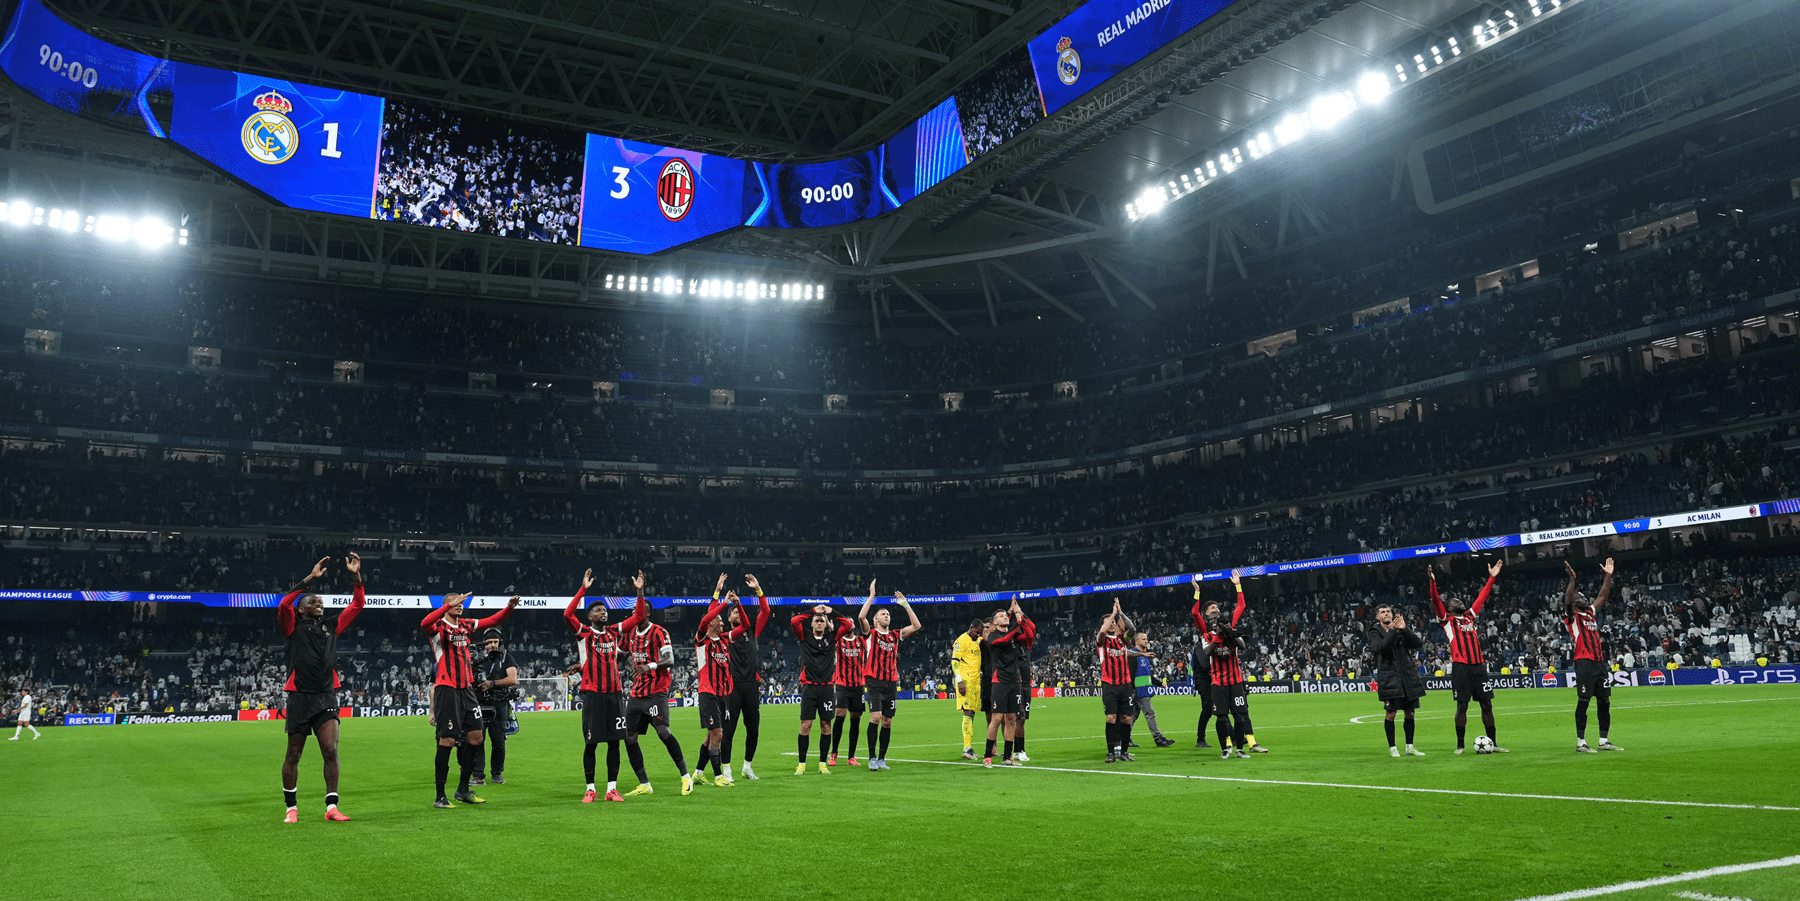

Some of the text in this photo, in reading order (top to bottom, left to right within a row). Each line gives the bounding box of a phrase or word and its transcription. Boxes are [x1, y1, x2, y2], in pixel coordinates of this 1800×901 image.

[1097, 20, 1126, 47] REAL
[40, 44, 98, 88] 90:00
[321, 123, 342, 158] 1
[666, 163, 687, 176] ACM
[610, 166, 630, 200] 3
[801, 182, 854, 204] 90:00
[664, 206, 682, 214] 1899
[1680, 307, 1735, 328] Real Madrid
[1576, 334, 1627, 354] Real Madrid
[1486, 358, 1530, 374] Real Madrid
[1404, 379, 1446, 395] Real Madrid
[104, 433, 134, 441] Madrid
[203, 439, 229, 447] Madrid
[1698, 512, 1721, 521] MILAN
[1555, 530, 1580, 539] MADRID
[1293, 560, 1324, 569] CHAMPIONS
[1739, 670, 1797, 684] PS5
[1065, 688, 1090, 697] QATAR
[1300, 680, 1367, 693] Heineken
[515, 702, 551, 711] FedEx
[824, 701, 833, 711] 42
[1234, 696, 1245, 706] 80
[129, 714, 232, 724] FollowScores.com
[616, 716, 627, 729] 22
